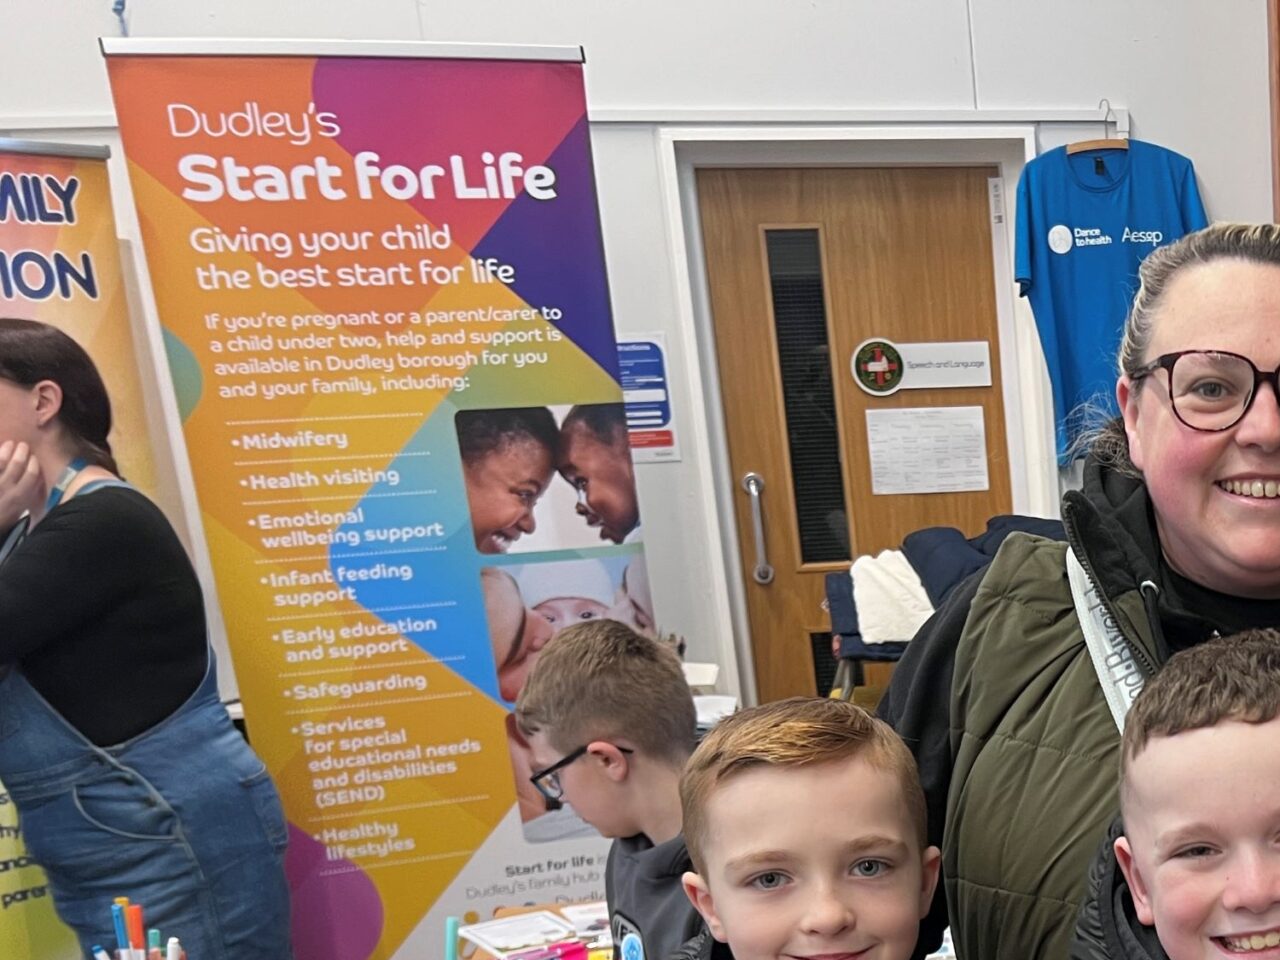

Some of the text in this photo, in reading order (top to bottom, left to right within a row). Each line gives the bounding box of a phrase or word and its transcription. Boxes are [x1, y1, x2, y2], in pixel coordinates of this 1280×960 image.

[167, 102, 341, 146] Dudley's
[178, 151, 558, 202] Start for Life
[190, 223, 451, 258] Giving your child
[1074, 227, 1163, 247] Dance Aesop
[1075, 235, 1112, 247] to health
[196, 258, 515, 290] the best start for life
[205, 306, 562, 332] If you're pregnant or a parent/carer to
[209, 325, 563, 353] a child under two, help and support is
[214, 349, 548, 376] available in Dudley borough for you
[219, 375, 471, 400] and your family, including:
[243, 430, 348, 451] Midwifery
[250, 467, 401, 491] Health visiting
[258, 508, 363, 531] Emotional
[262, 522, 444, 549] wellbeing support
[270, 564, 413, 587] Infant feeding
[274, 586, 357, 608] support
[282, 618, 437, 645] Early education
[286, 638, 409, 663] and support
[293, 673, 427, 700] Safeguarding
[301, 715, 386, 737] Services
[304, 728, 407, 755] for special
[308, 737, 482, 773] educational needs
[312, 760, 458, 790] and disabilities
[315, 784, 386, 809] (SEND)
[323, 820, 399, 842] Healthy
[325, 837, 416, 861] lifestyles
[505, 860, 545, 878] Start
[547, 859, 569, 872] for
[571, 855, 594, 867] life
